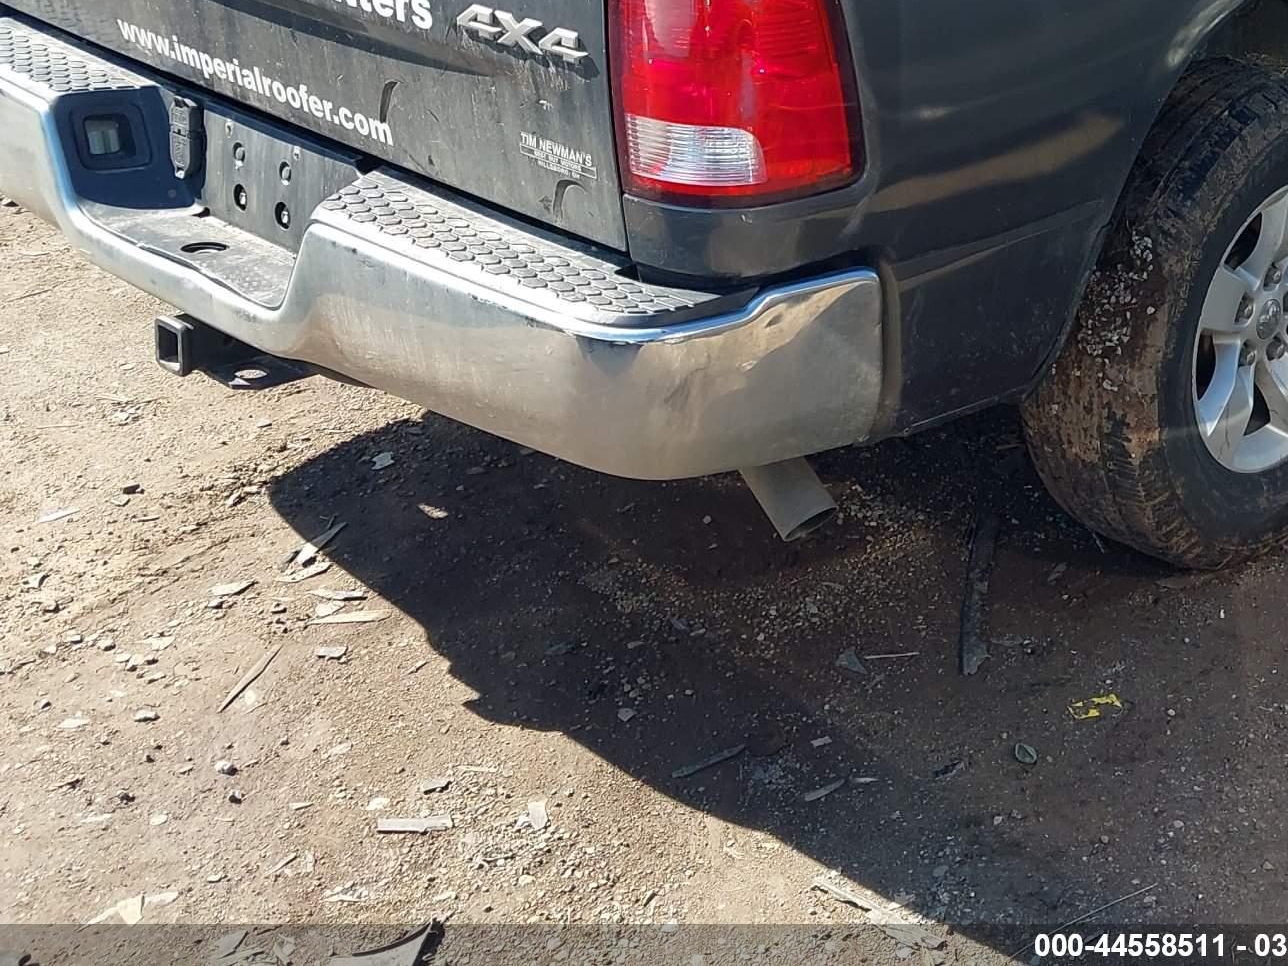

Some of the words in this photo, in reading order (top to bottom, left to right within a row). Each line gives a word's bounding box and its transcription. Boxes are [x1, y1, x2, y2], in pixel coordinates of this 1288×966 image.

[117, 18, 394, 147] www.imperialroofer.com
[520, 131, 537, 148] TIM
[539, 138, 592, 167] NEWMAN'S
